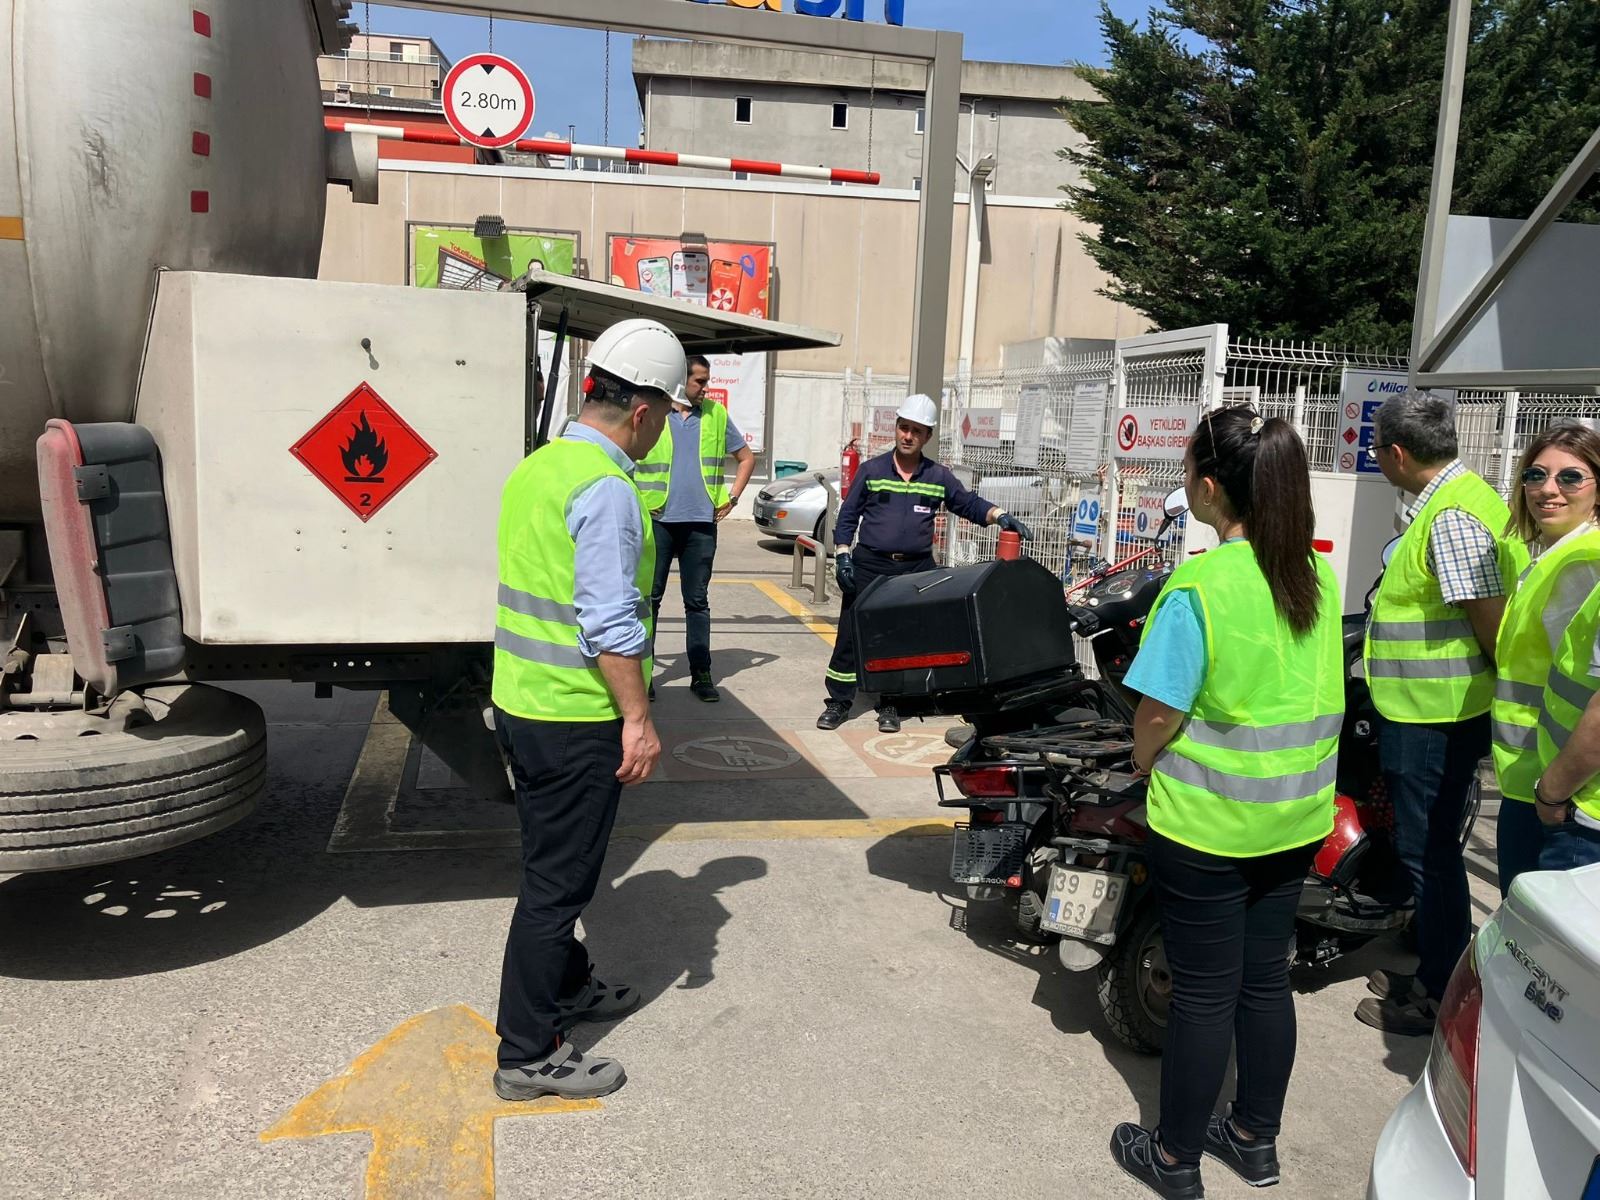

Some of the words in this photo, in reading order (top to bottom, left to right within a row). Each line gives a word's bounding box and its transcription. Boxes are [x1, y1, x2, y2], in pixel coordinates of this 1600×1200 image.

[461, 91, 516, 111] 2.80m
[1137, 435, 1166, 449] BAŞKASI
[360, 493, 371, 506] 2
[1055, 872, 1080, 894] 39
[1092, 878, 1119, 901] BG
[1062, 901, 1098, 925] 631
[1505, 939, 1570, 1001] ACCENT
